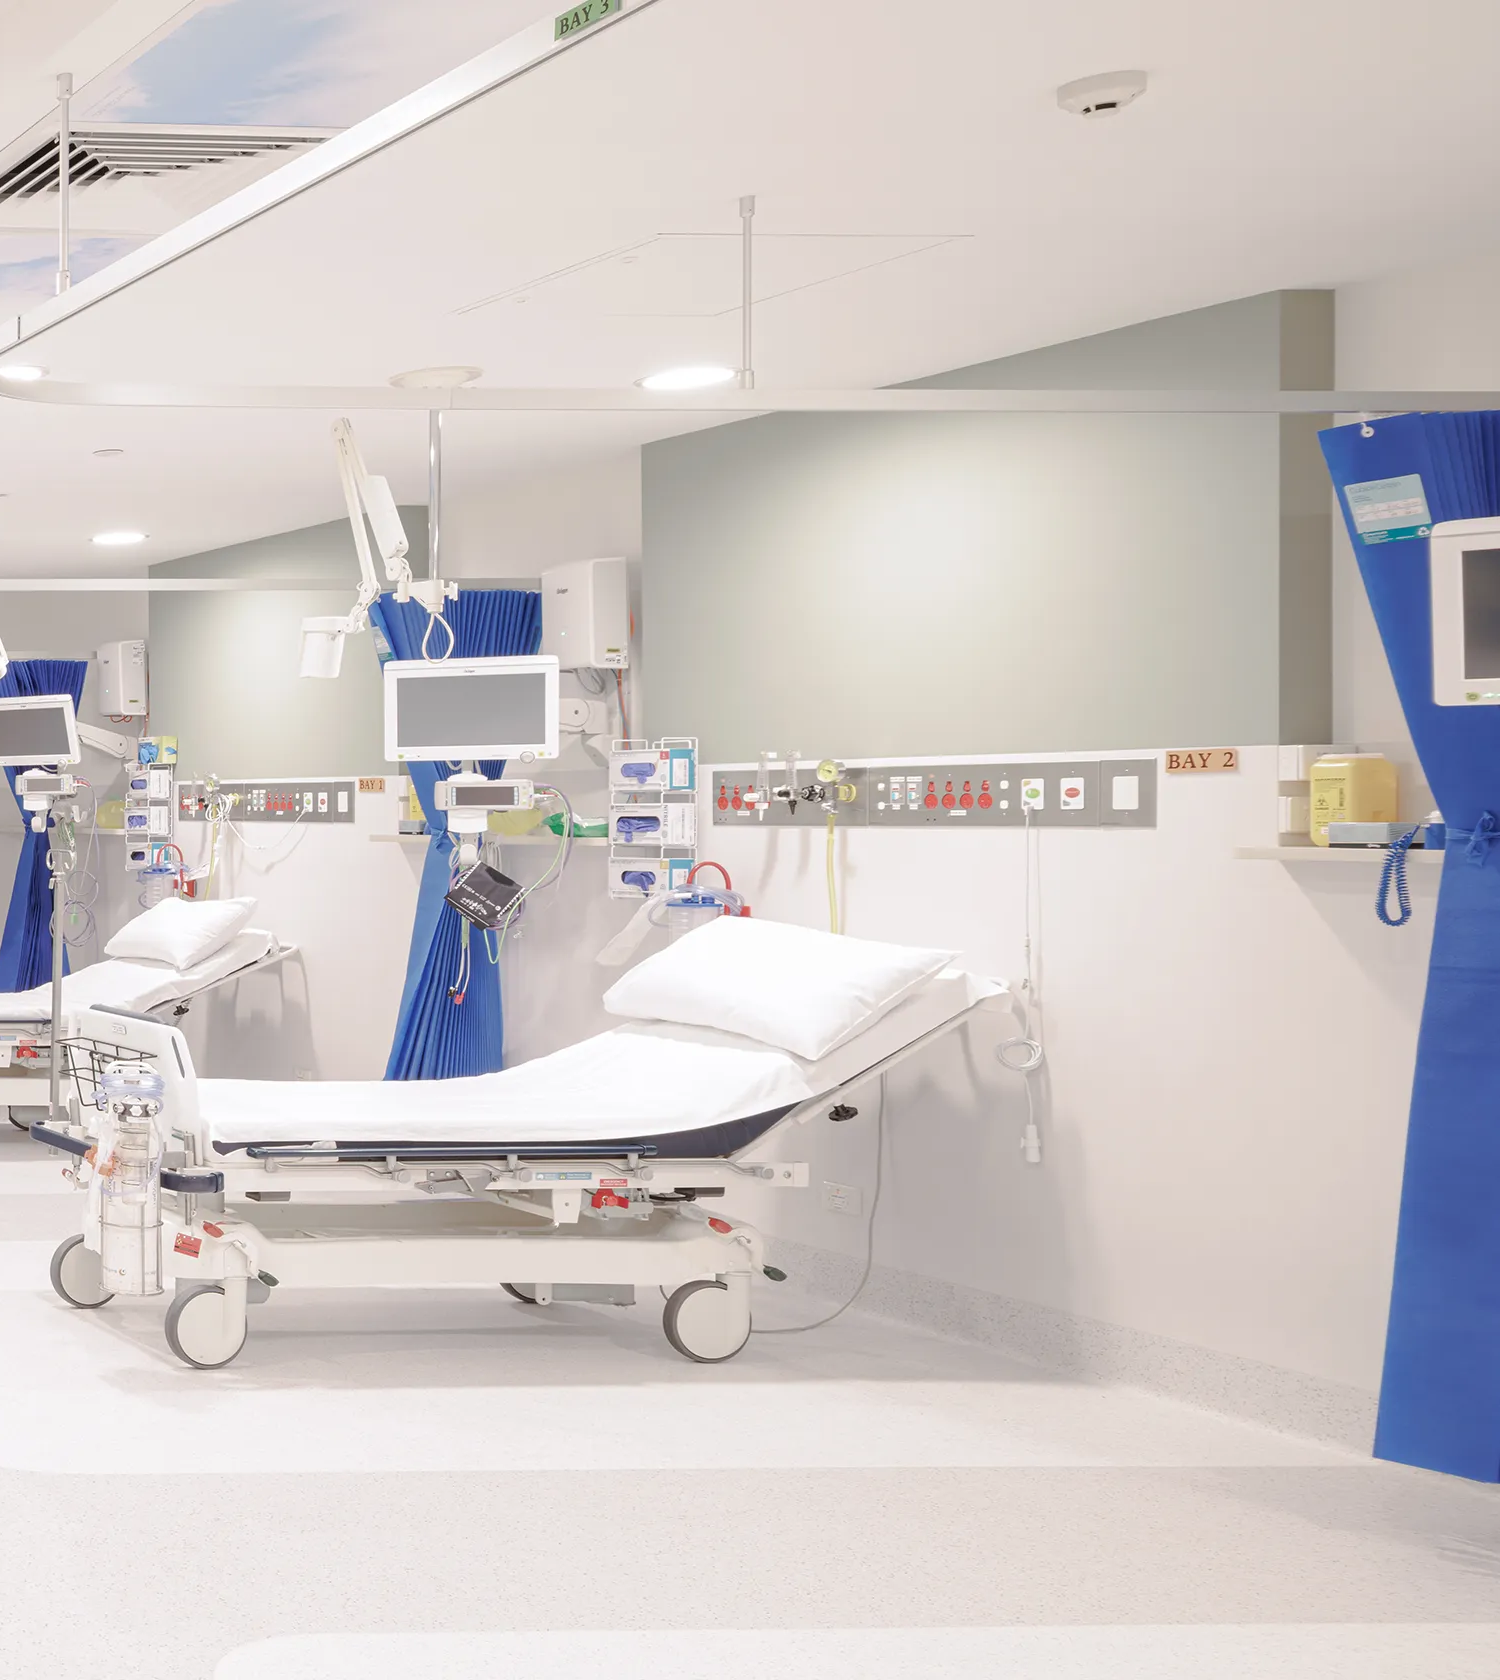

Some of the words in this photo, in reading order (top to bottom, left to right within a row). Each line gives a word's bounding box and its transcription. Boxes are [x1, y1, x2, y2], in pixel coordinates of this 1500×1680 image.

[559, 3, 593, 36] BAY
[600, 0, 609, 14] 3
[1167, 752, 1212, 770] BAY
[1222, 751, 1234, 768] 2
[359, 779, 376, 790] BAY
[378, 780, 384, 790] 1
